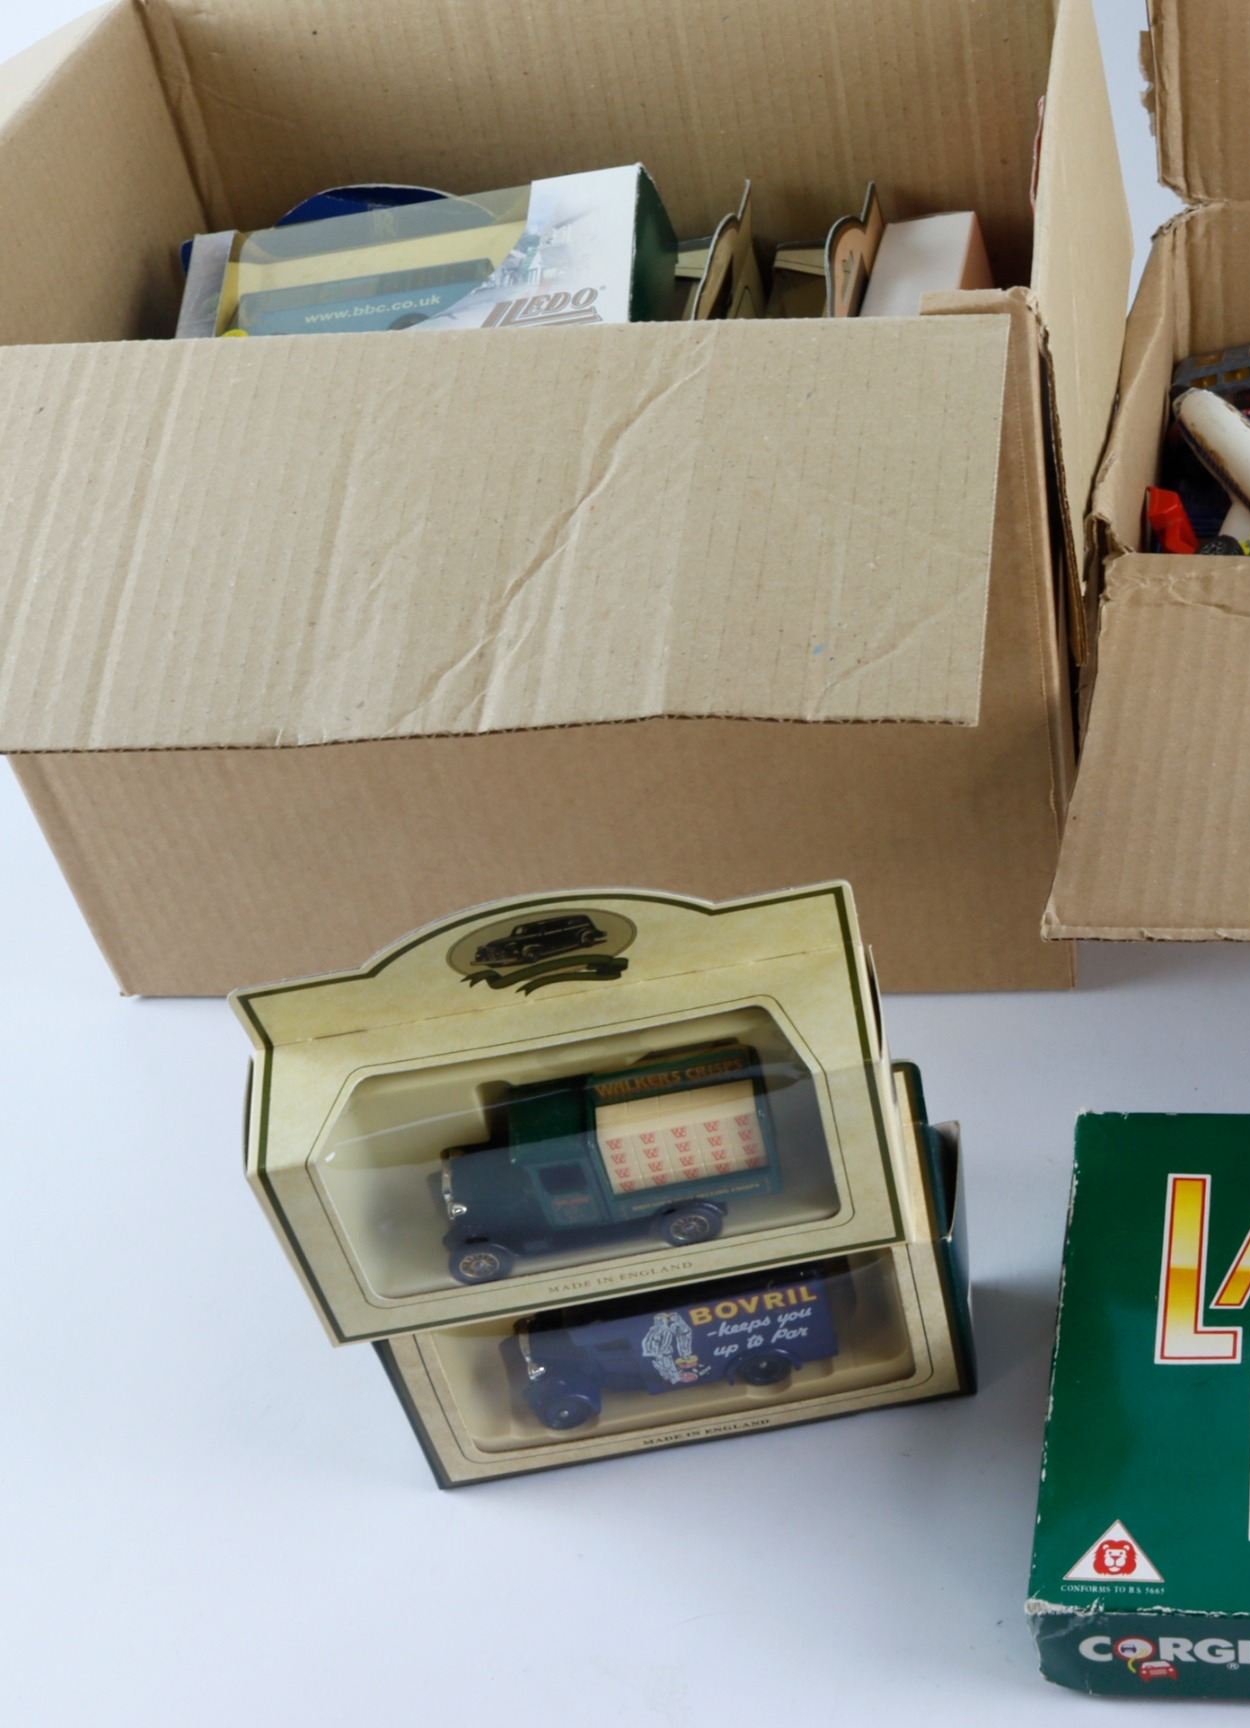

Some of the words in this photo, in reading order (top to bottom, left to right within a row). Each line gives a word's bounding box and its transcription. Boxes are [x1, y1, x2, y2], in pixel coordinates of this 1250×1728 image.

[304, 294, 441, 324] www.bbc.co.uk
[594, 1070, 682, 1098] WALKERS
[686, 1058, 744, 1080] CRISPS
[548, 1281, 592, 1294] MADE
[597, 1276, 613, 1285] IN
[620, 1261, 693, 1280] ENGLAND
[689, 1285, 817, 1326] BOVRIL
[777, 1307, 812, 1328] you
[713, 1343, 739, 1357] up
[747, 1334, 764, 1349] to
[643, 1434, 682, 1446] MADE
[686, 1430, 700, 1438] IN
[705, 1419, 770, 1435] ENGLAND
[1060, 1584, 1111, 1593] CONFORMS
[1114, 1585, 1126, 1593] TO
